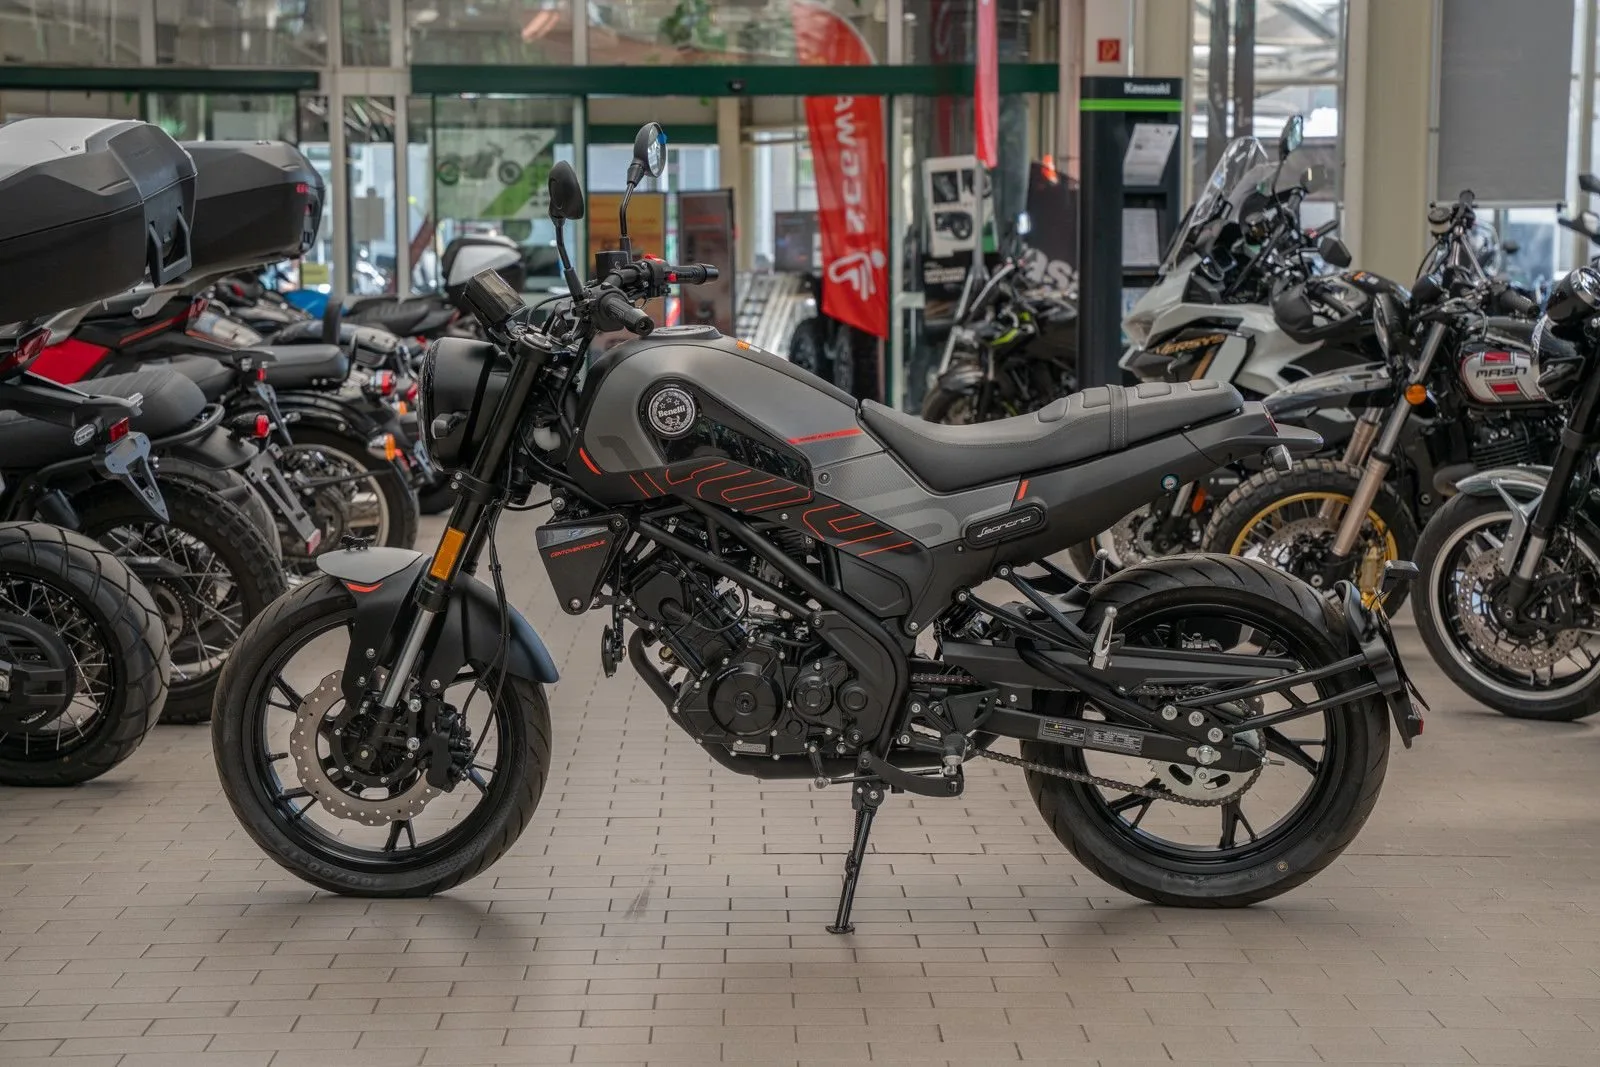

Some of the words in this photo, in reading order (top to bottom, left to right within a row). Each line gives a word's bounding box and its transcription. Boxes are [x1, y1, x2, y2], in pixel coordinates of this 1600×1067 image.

[1123, 82, 1171, 96] Kawasaki
[1476, 365, 1527, 378] MASH
[657, 405, 686, 418] Benelli
